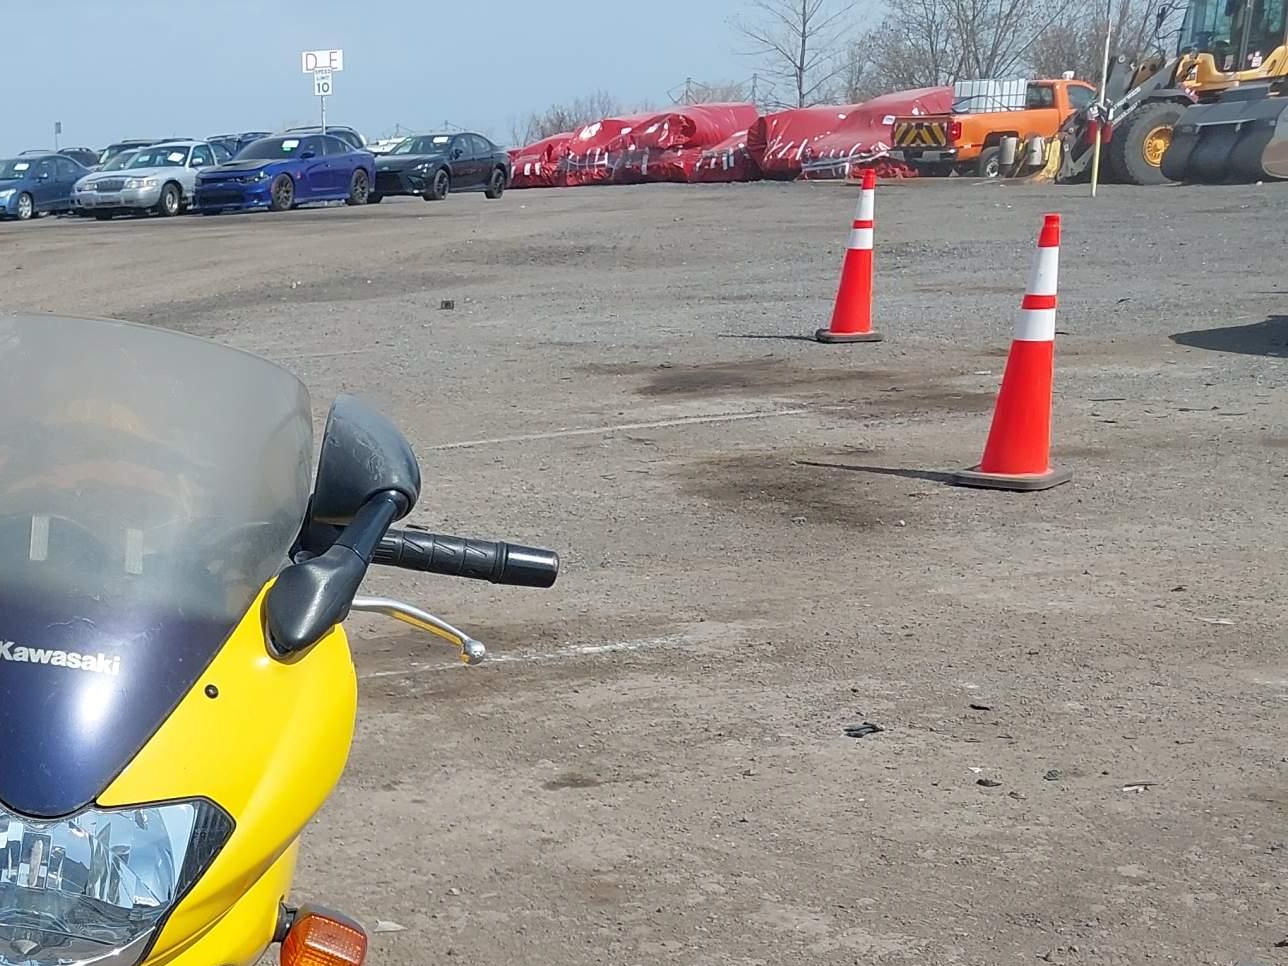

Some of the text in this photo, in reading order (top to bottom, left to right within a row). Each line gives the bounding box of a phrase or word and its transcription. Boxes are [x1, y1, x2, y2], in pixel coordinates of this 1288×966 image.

[305, 51, 338, 71] D E
[317, 82, 330, 93] 10
